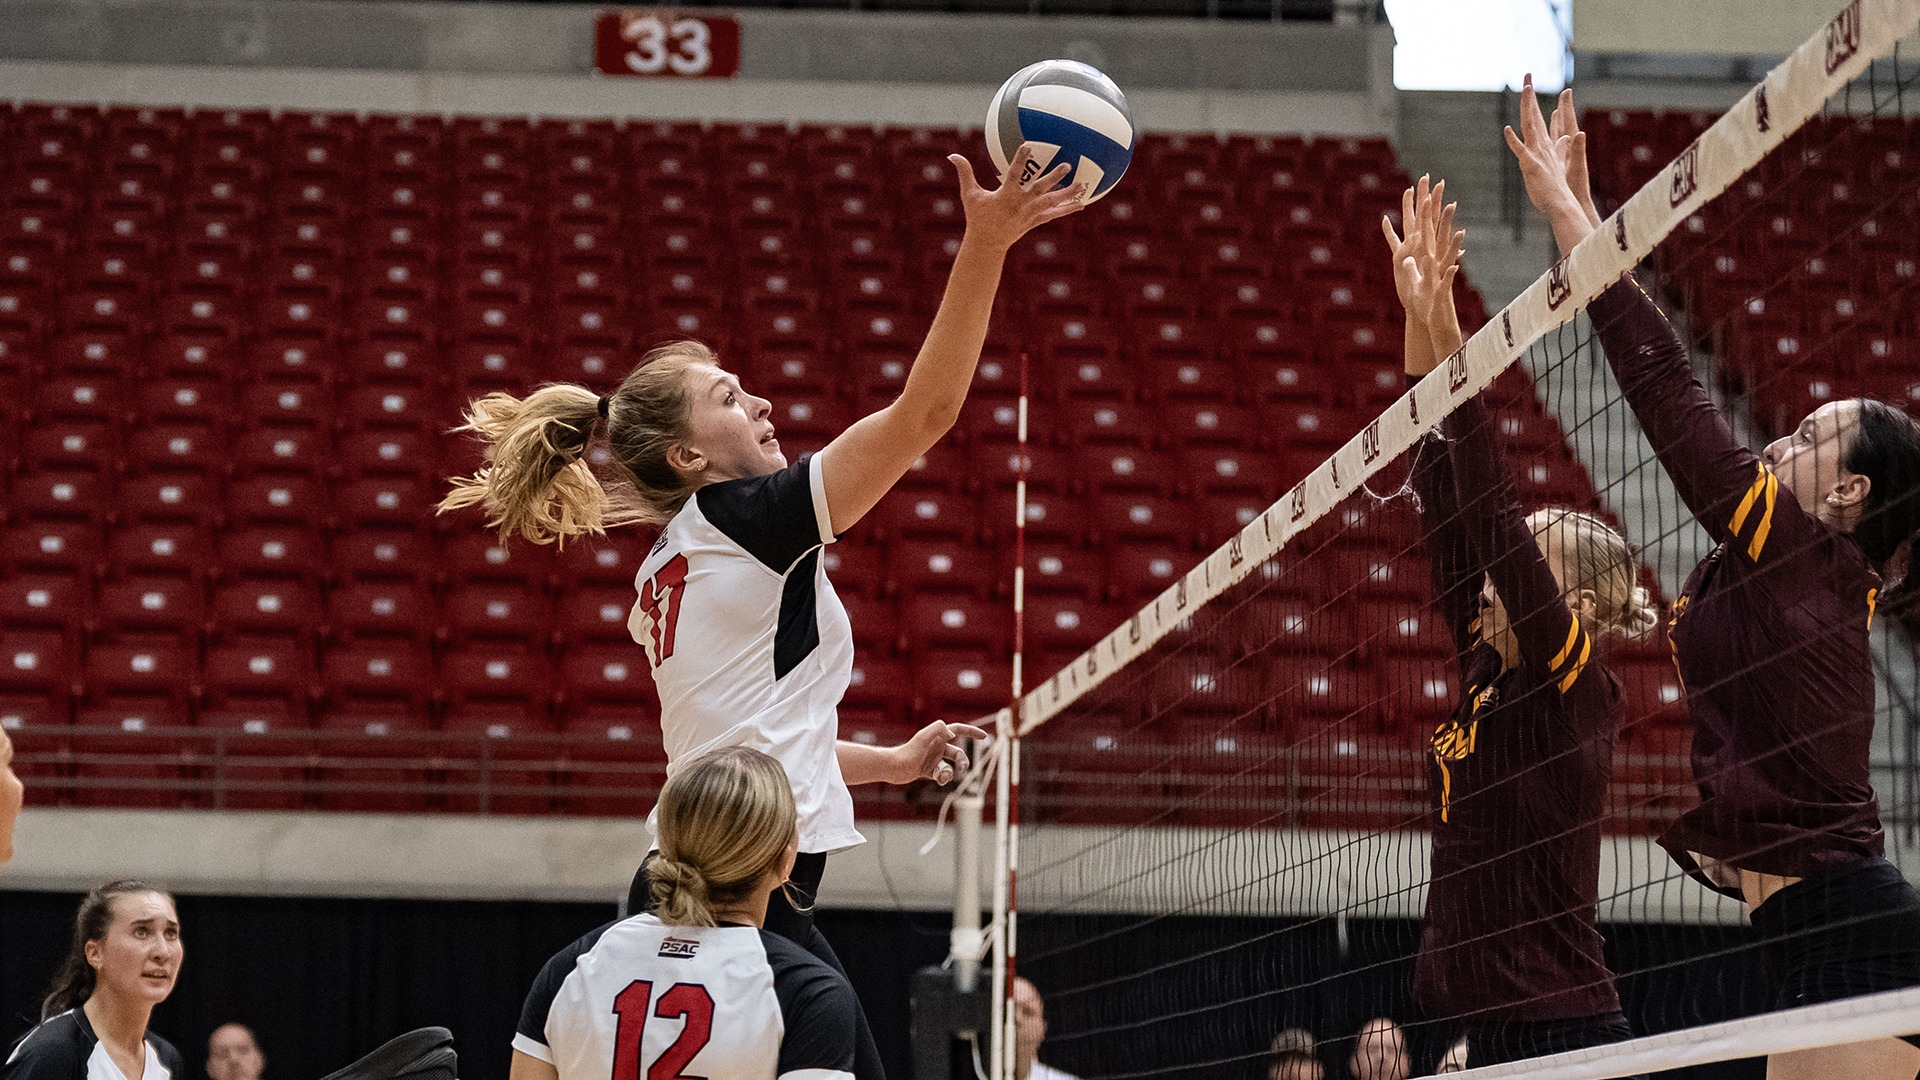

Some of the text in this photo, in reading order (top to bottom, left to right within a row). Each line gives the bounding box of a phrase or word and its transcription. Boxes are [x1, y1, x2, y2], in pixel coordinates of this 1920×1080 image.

[625, 17, 711, 74] 33
[640, 552, 689, 668] 17
[660, 942, 699, 955] PSAC
[612, 979, 715, 1080] 12
